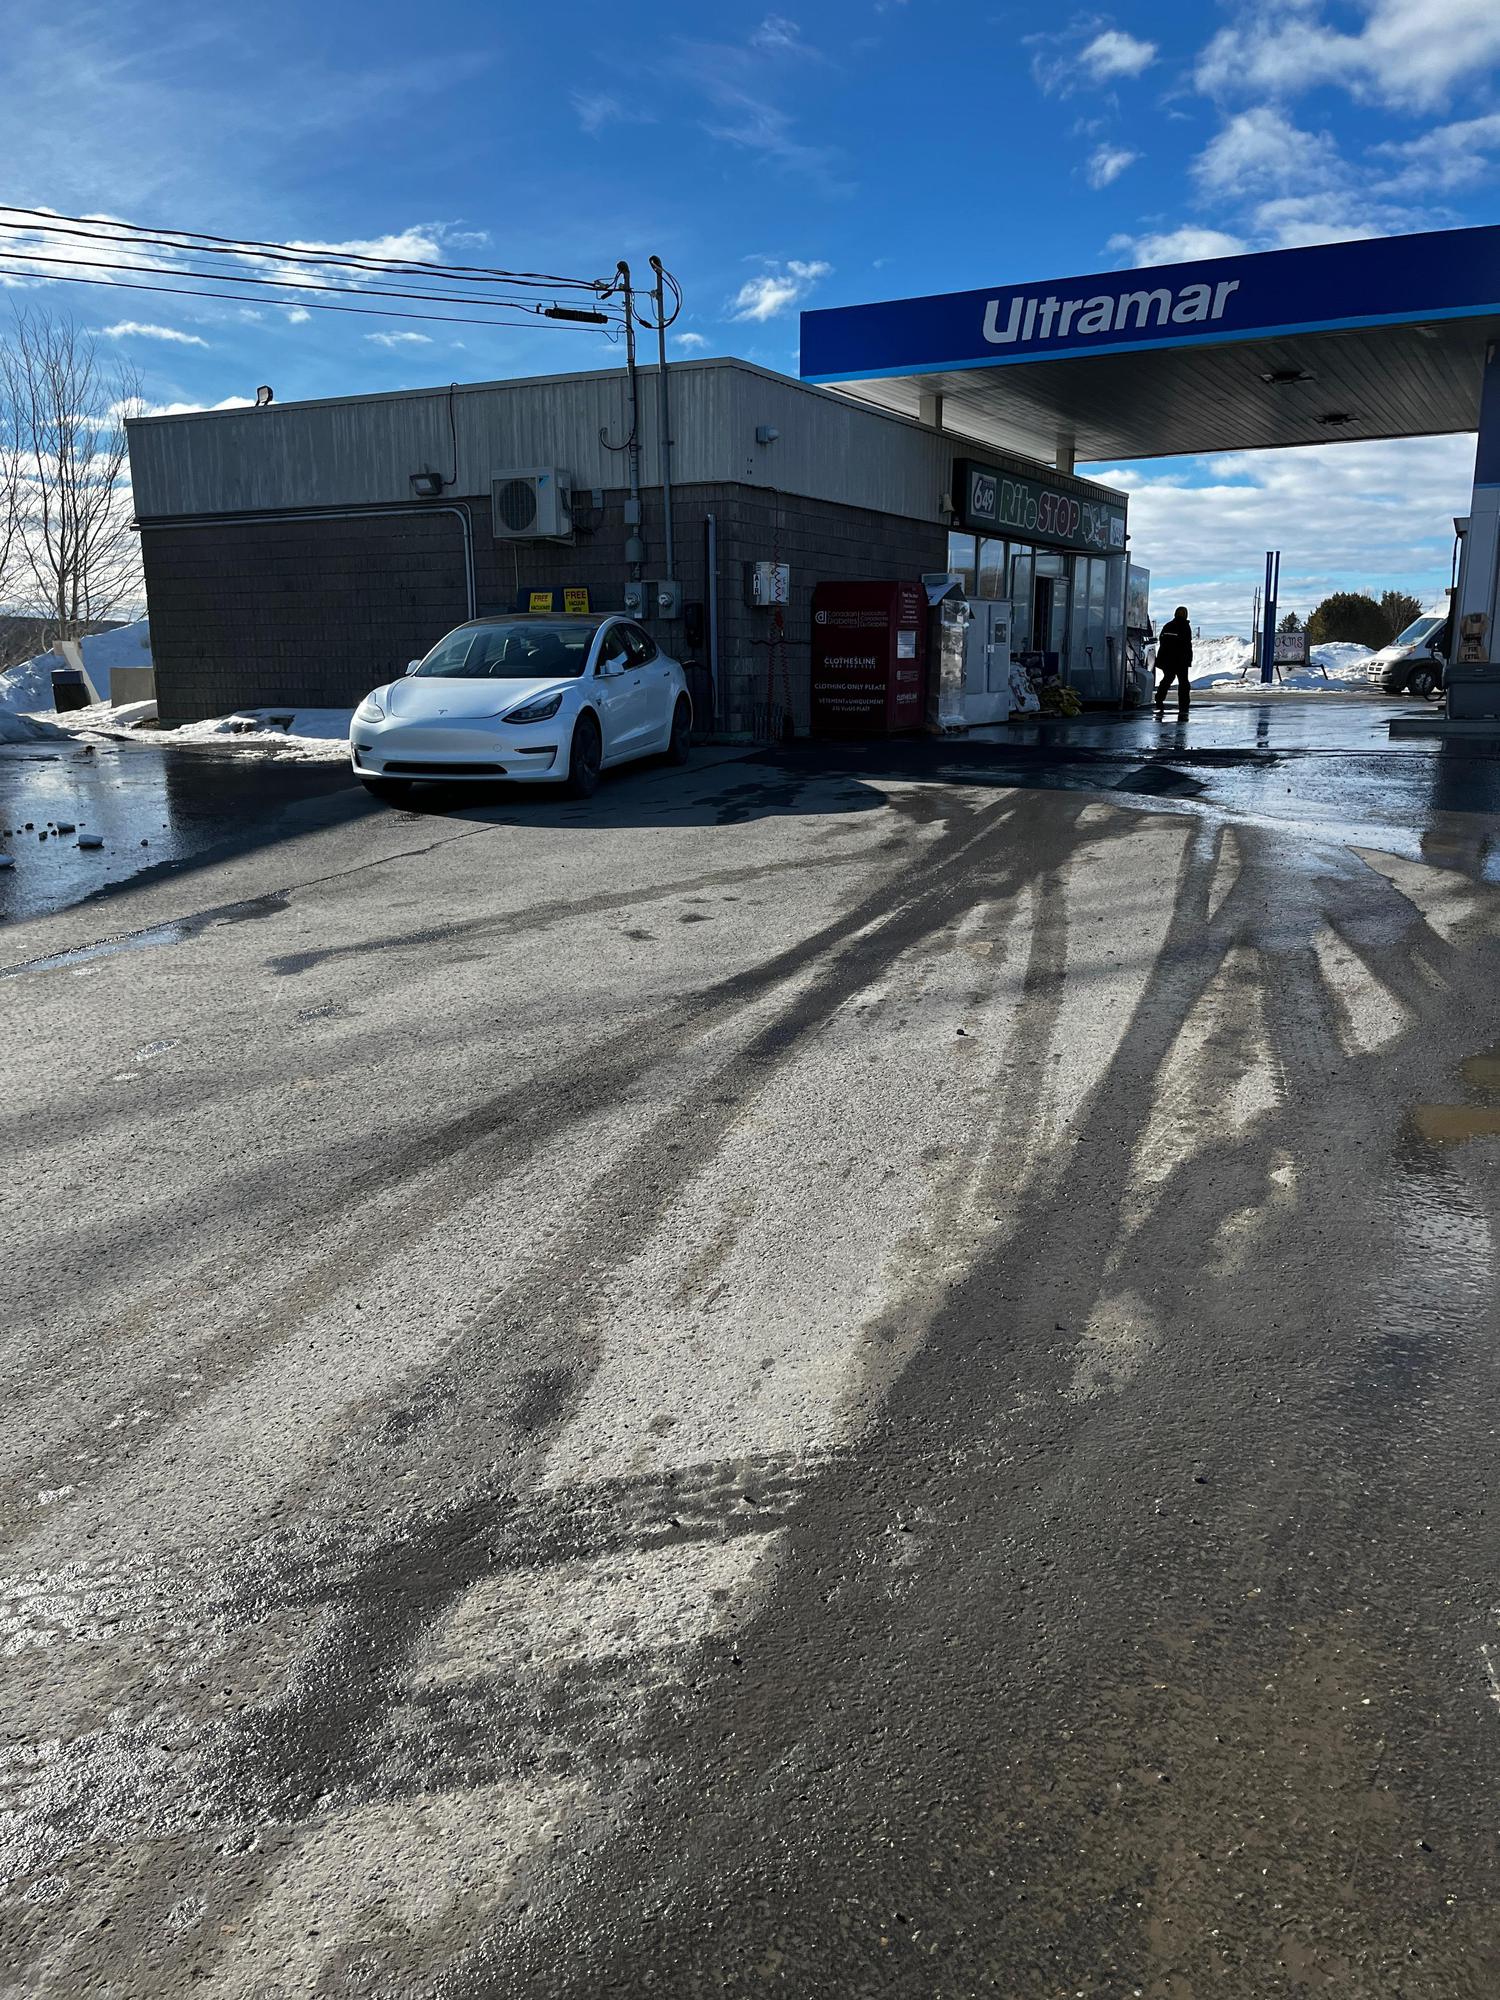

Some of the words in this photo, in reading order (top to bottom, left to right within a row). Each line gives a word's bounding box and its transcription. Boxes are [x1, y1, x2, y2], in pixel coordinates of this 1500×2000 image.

[982, 279, 1240, 344] Ultramar
[566, 591, 586, 599] FREE
[824, 657, 876, 665] CLOTHESLINE
